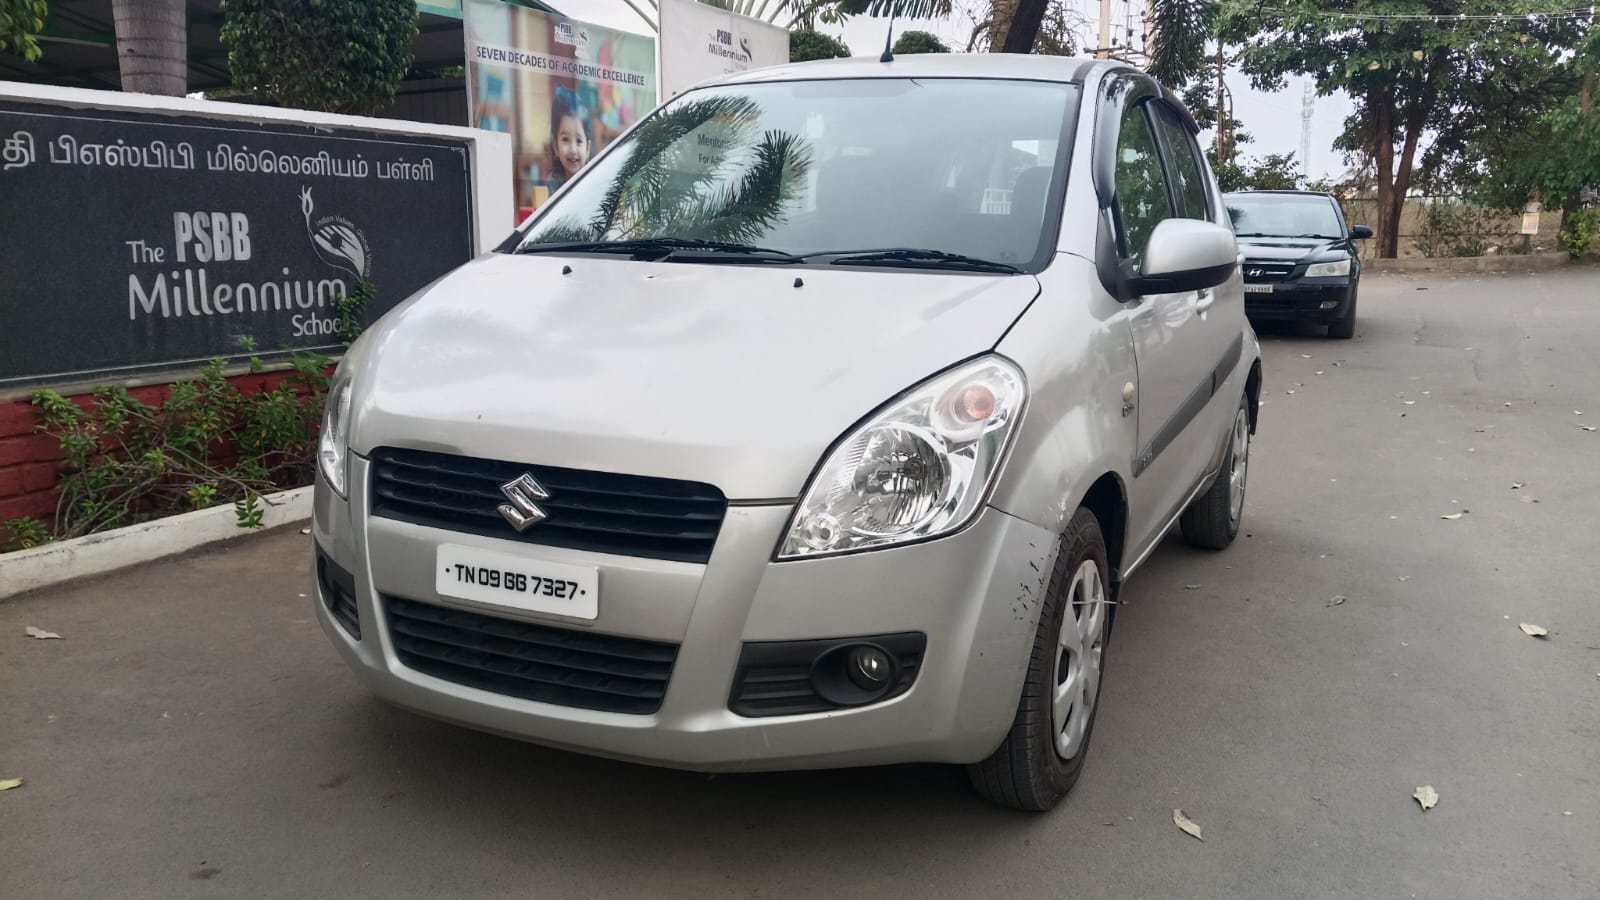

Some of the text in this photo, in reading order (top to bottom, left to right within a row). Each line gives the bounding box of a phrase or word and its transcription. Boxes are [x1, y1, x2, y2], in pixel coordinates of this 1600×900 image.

[708, 43, 748, 63] Millennium
[716, 29, 732, 46] PSBB
[476, 46, 645, 86] SEVEN DECADES OF ACADEMIC EXCELLENCE
[3, 131, 434, 181] தி பிஎஸ்பிபி மில்லெனியம் பள்ளி
[125, 211, 251, 264] The PSBB
[128, 266, 347, 321] Millennium
[291, 312, 344, 337] Schoo
[454, 563, 475, 584] TN
[478, 567, 501, 588] 09
[530, 575, 578, 601] 7327
